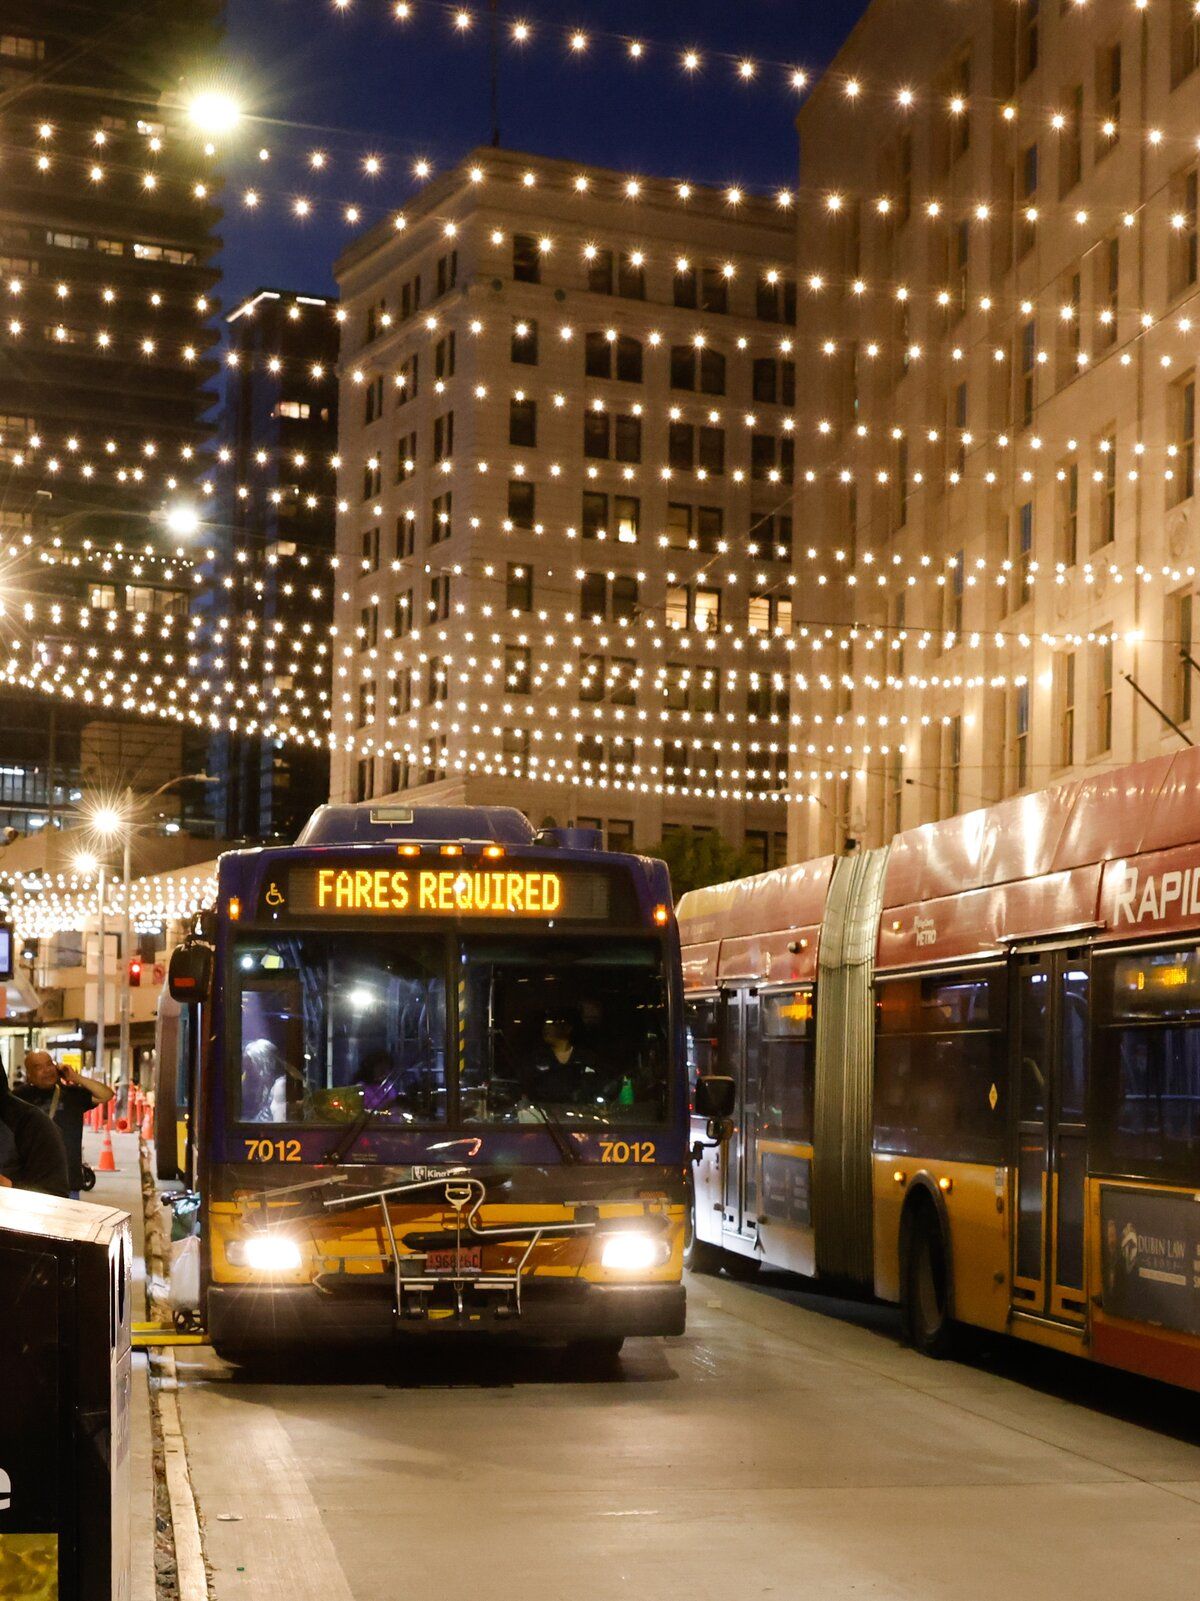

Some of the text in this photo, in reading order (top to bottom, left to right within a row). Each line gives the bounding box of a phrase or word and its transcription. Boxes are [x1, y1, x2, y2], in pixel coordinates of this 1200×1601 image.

[319, 870, 560, 910] FARES REQUIRED
[245, 1140, 300, 1162] 7012
[601, 1141, 655, 1163] 7012
[1168, 1240, 1185, 1258] LAW
